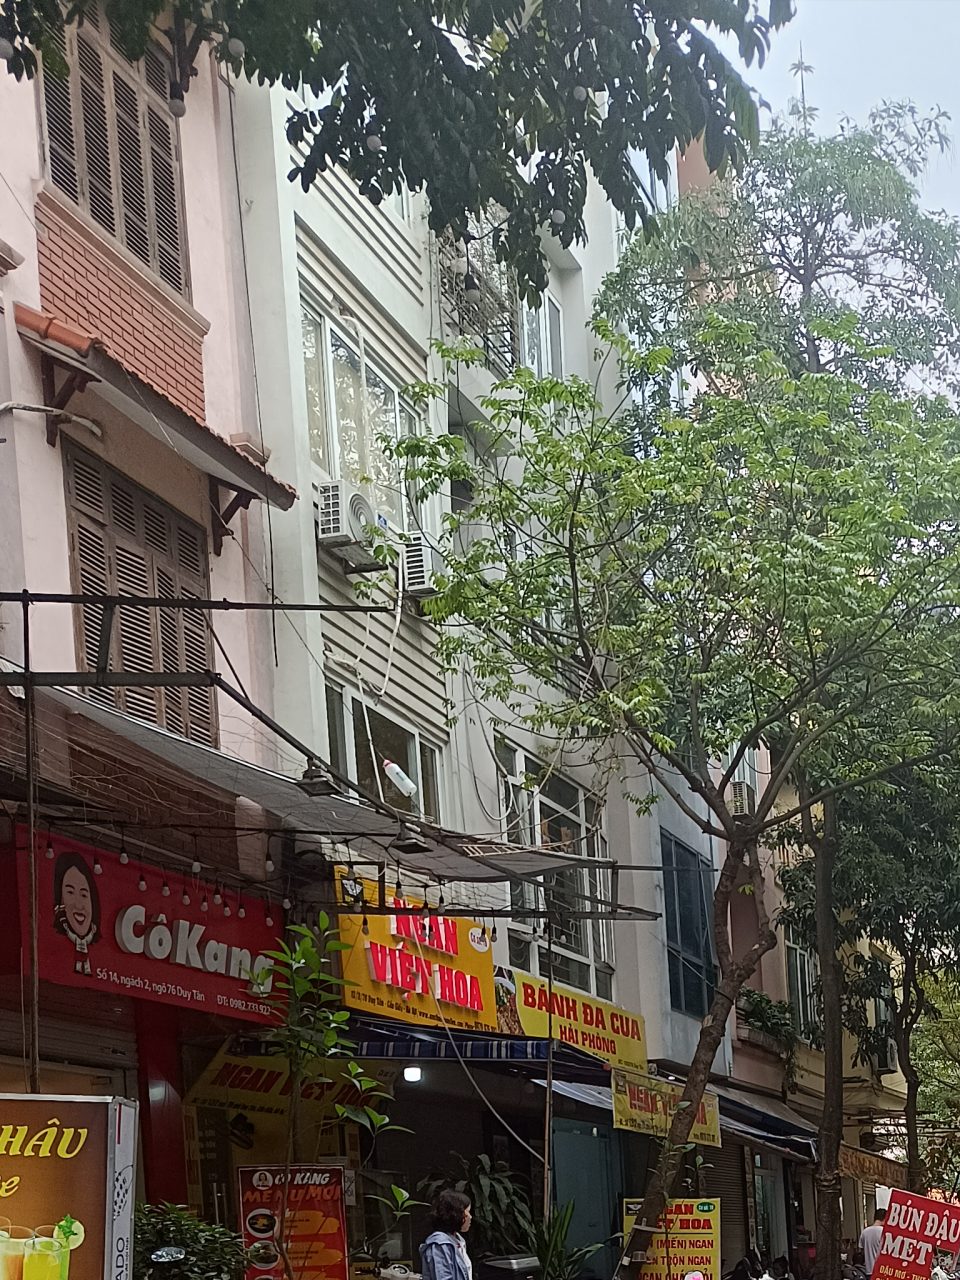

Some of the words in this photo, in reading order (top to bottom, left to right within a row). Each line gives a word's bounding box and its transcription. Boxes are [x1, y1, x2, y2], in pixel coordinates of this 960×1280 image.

[366, 940, 433, 1000] VIỆT
[436, 964, 484, 1012] HOA
[167, 983, 176, 996] 76
[177, 986, 192, 1001] Duy
[522, 982, 578, 1022] BÁNH
[582, 1003, 607, 1031] ĐA
[610, 1013, 641, 1041] CUA
[559, 1023, 580, 1046] HẢI
[582, 1033, 617, 1055] PHÒNG
[679, 1219, 713, 1230] HOA
[887, 1200, 924, 1233] BÚN
[688, 1240, 714, 1249] NGAN
[881, 1232, 933, 1267] MẸT
[687, 1256, 712, 1266] NGAN
[879, 1264, 894, 1277] ĐẬU
